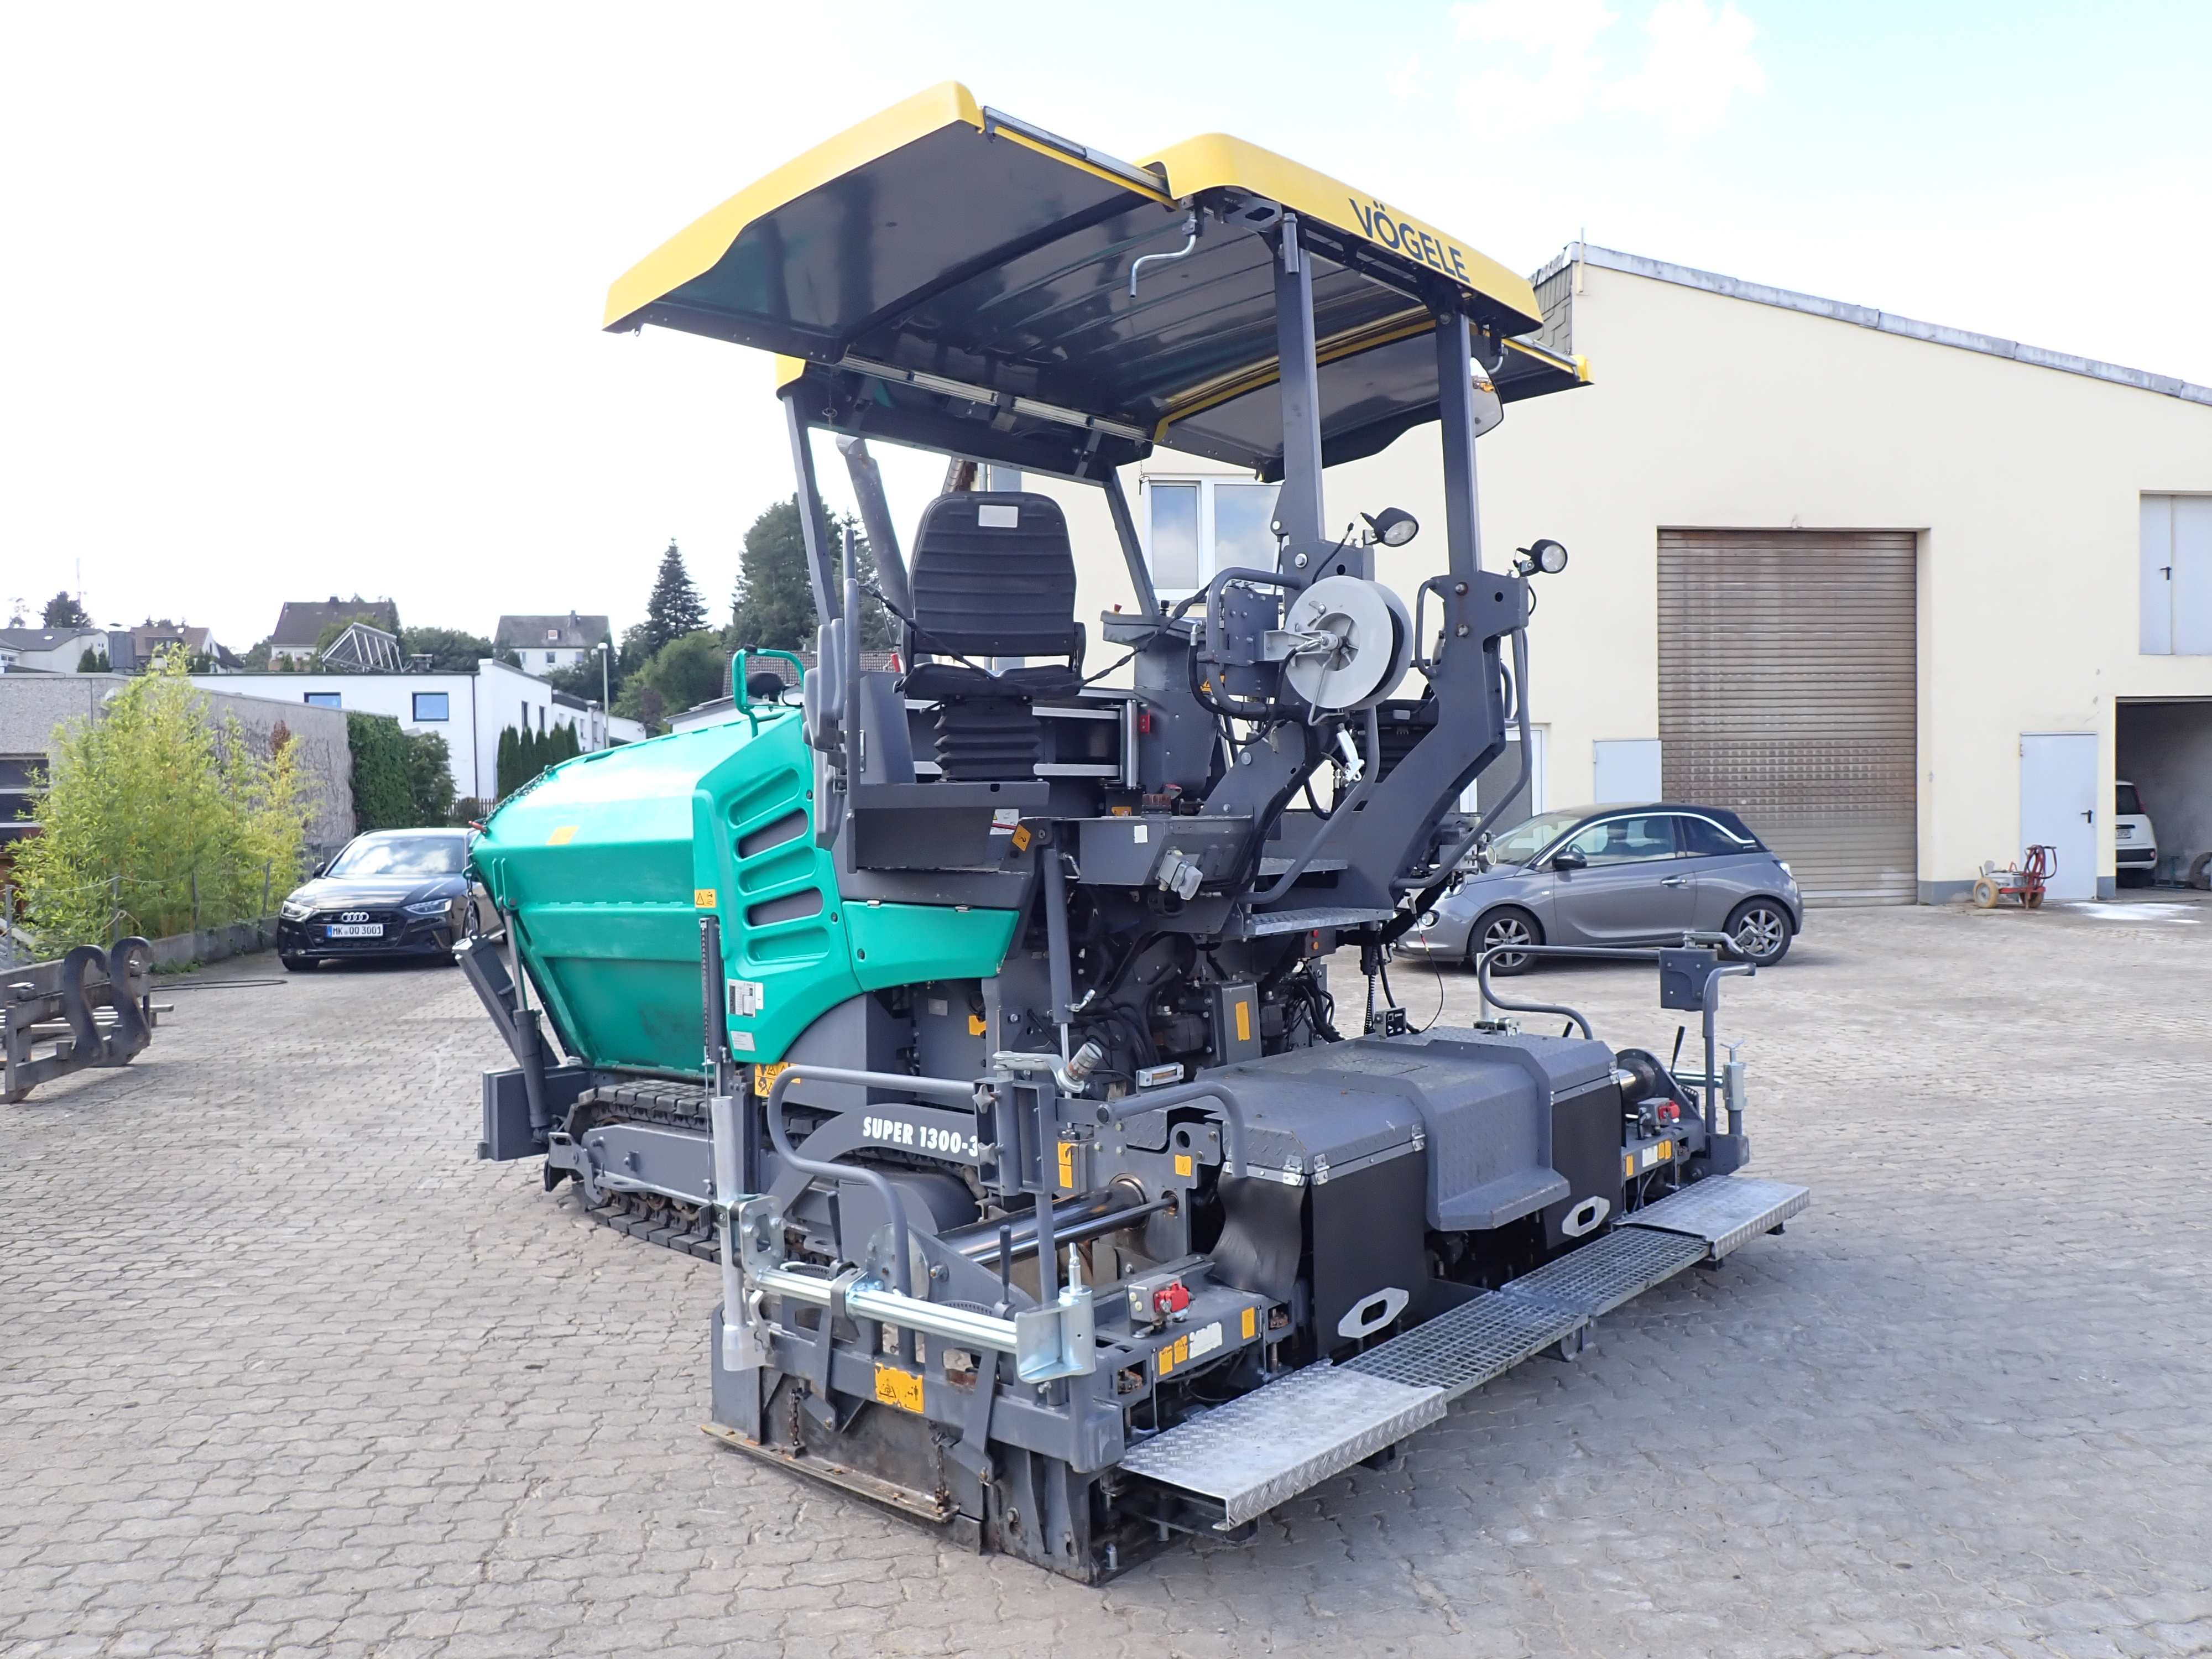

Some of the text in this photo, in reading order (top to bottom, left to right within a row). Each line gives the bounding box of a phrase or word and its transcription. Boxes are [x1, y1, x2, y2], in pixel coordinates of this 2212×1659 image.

[1348, 197, 1472, 284] VÖGELE
[362, 925, 382, 935] 3001
[863, 1116, 978, 1157] SUPER 1300-3
